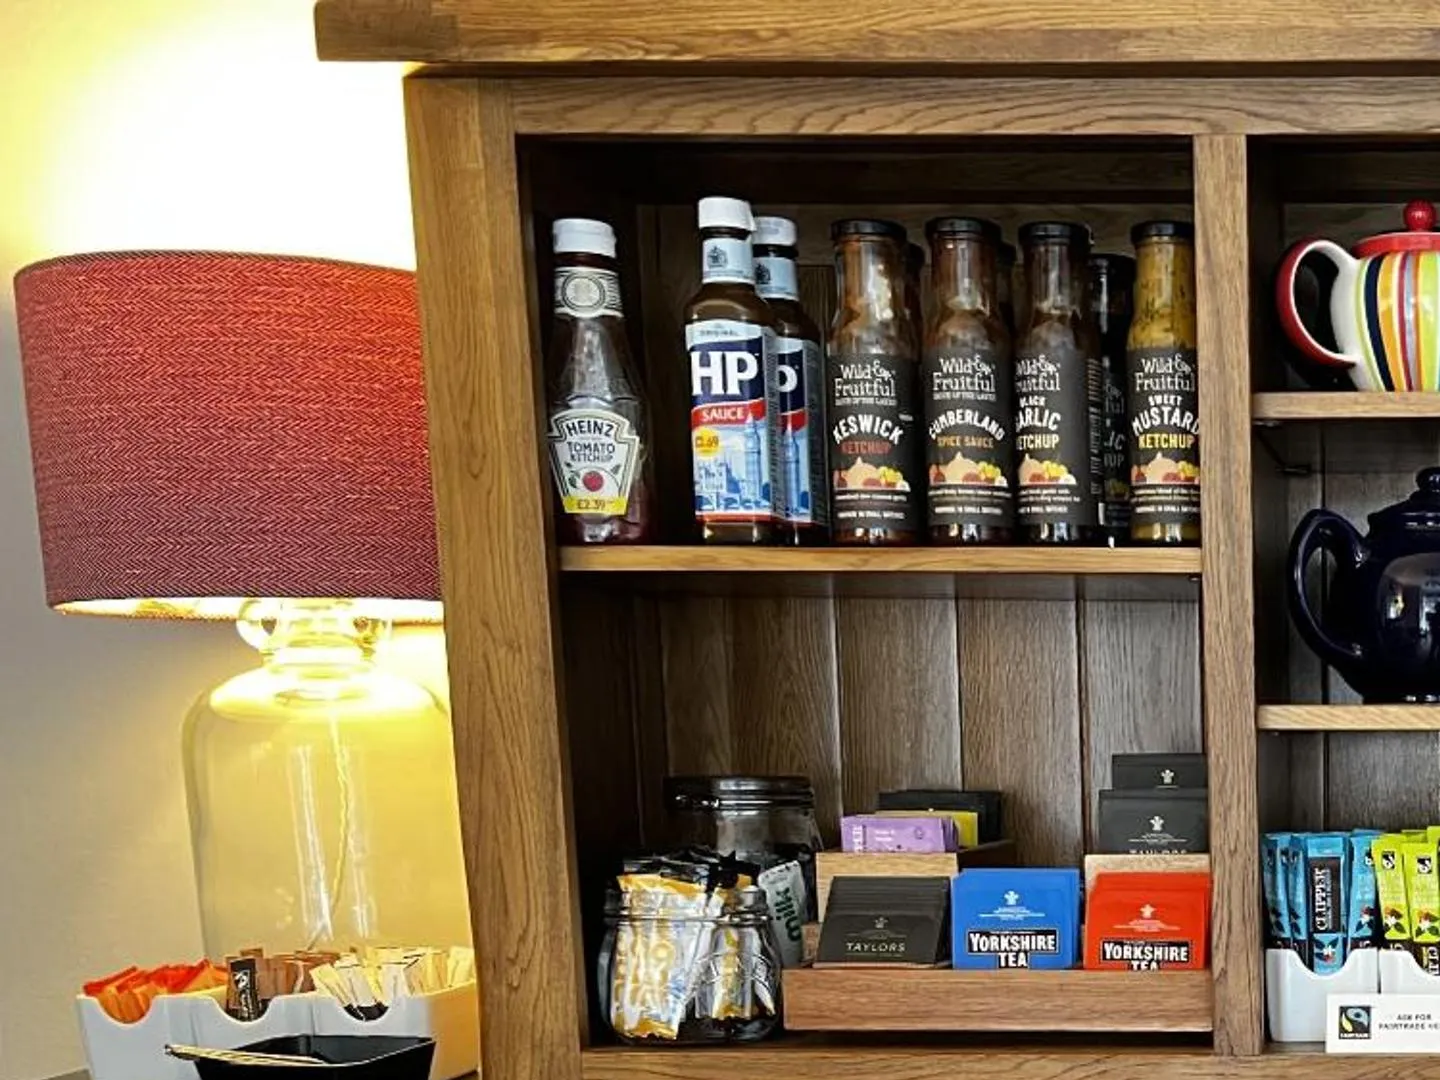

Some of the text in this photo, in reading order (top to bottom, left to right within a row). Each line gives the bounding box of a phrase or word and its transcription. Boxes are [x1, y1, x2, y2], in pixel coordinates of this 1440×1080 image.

[691, 351, 758, 395] HP
[840, 364, 871, 379] Wild
[939, 358, 971, 374] Wild
[1141, 357, 1172, 374] Wild
[835, 378, 896, 397] Fruitful
[932, 372, 996, 392] Fruitful
[1134, 372, 1196, 392] Fruitful
[702, 407, 745, 422] SAUCE
[1131, 406, 1200, 437] MUSTARD
[566, 420, 615, 437] HEINZ
[832, 413, 904, 445] KESWICK
[928, 408, 1006, 442] CUMBERLAND
[567, 442, 616, 454] TOMATO
[842, 441, 892, 454] KETCHUP
[1138, 433, 1196, 449] KETCHUP
[1314, 868, 1328, 931] CLIPPER
[774, 887, 802, 942] milk
[846, 942, 906, 952] TAYLORS
[969, 932, 1056, 952] YORKSHIRE
[1103, 942, 1189, 961] YORKSHIRE
[999, 952, 1028, 967] TEA
